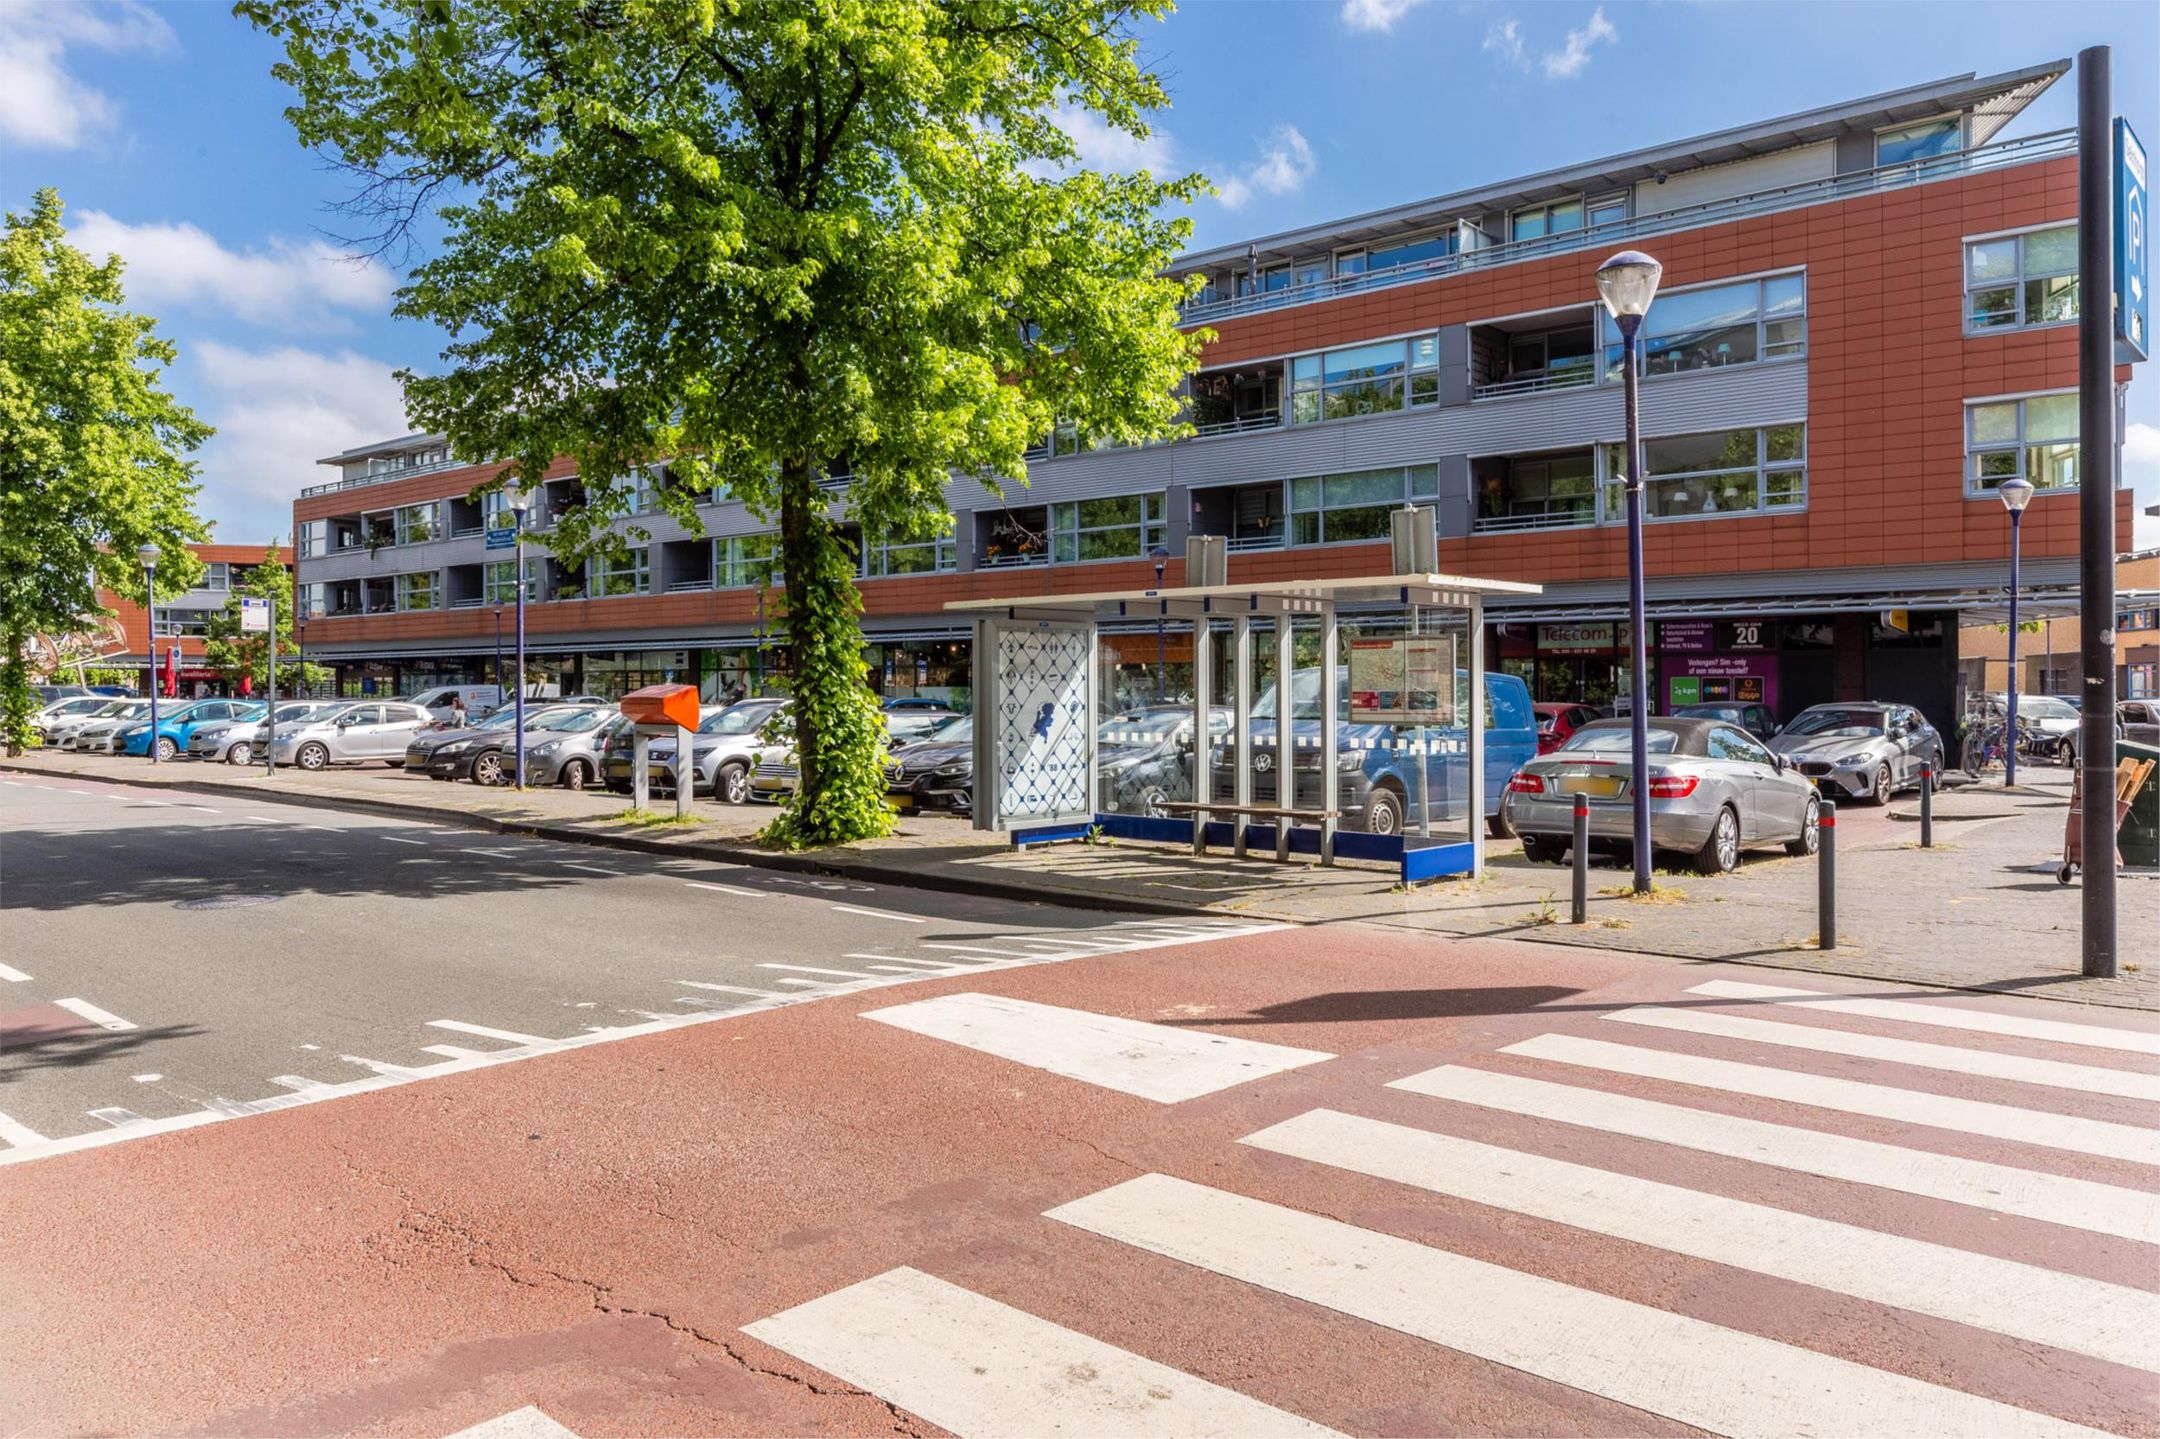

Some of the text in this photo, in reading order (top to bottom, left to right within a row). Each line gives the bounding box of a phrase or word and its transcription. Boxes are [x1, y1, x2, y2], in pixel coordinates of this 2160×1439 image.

[1737, 627, 1758, 644] 20
[1688, 658, 1718, 667] Verlengen?
[1720, 658, 1731, 666] Sim
